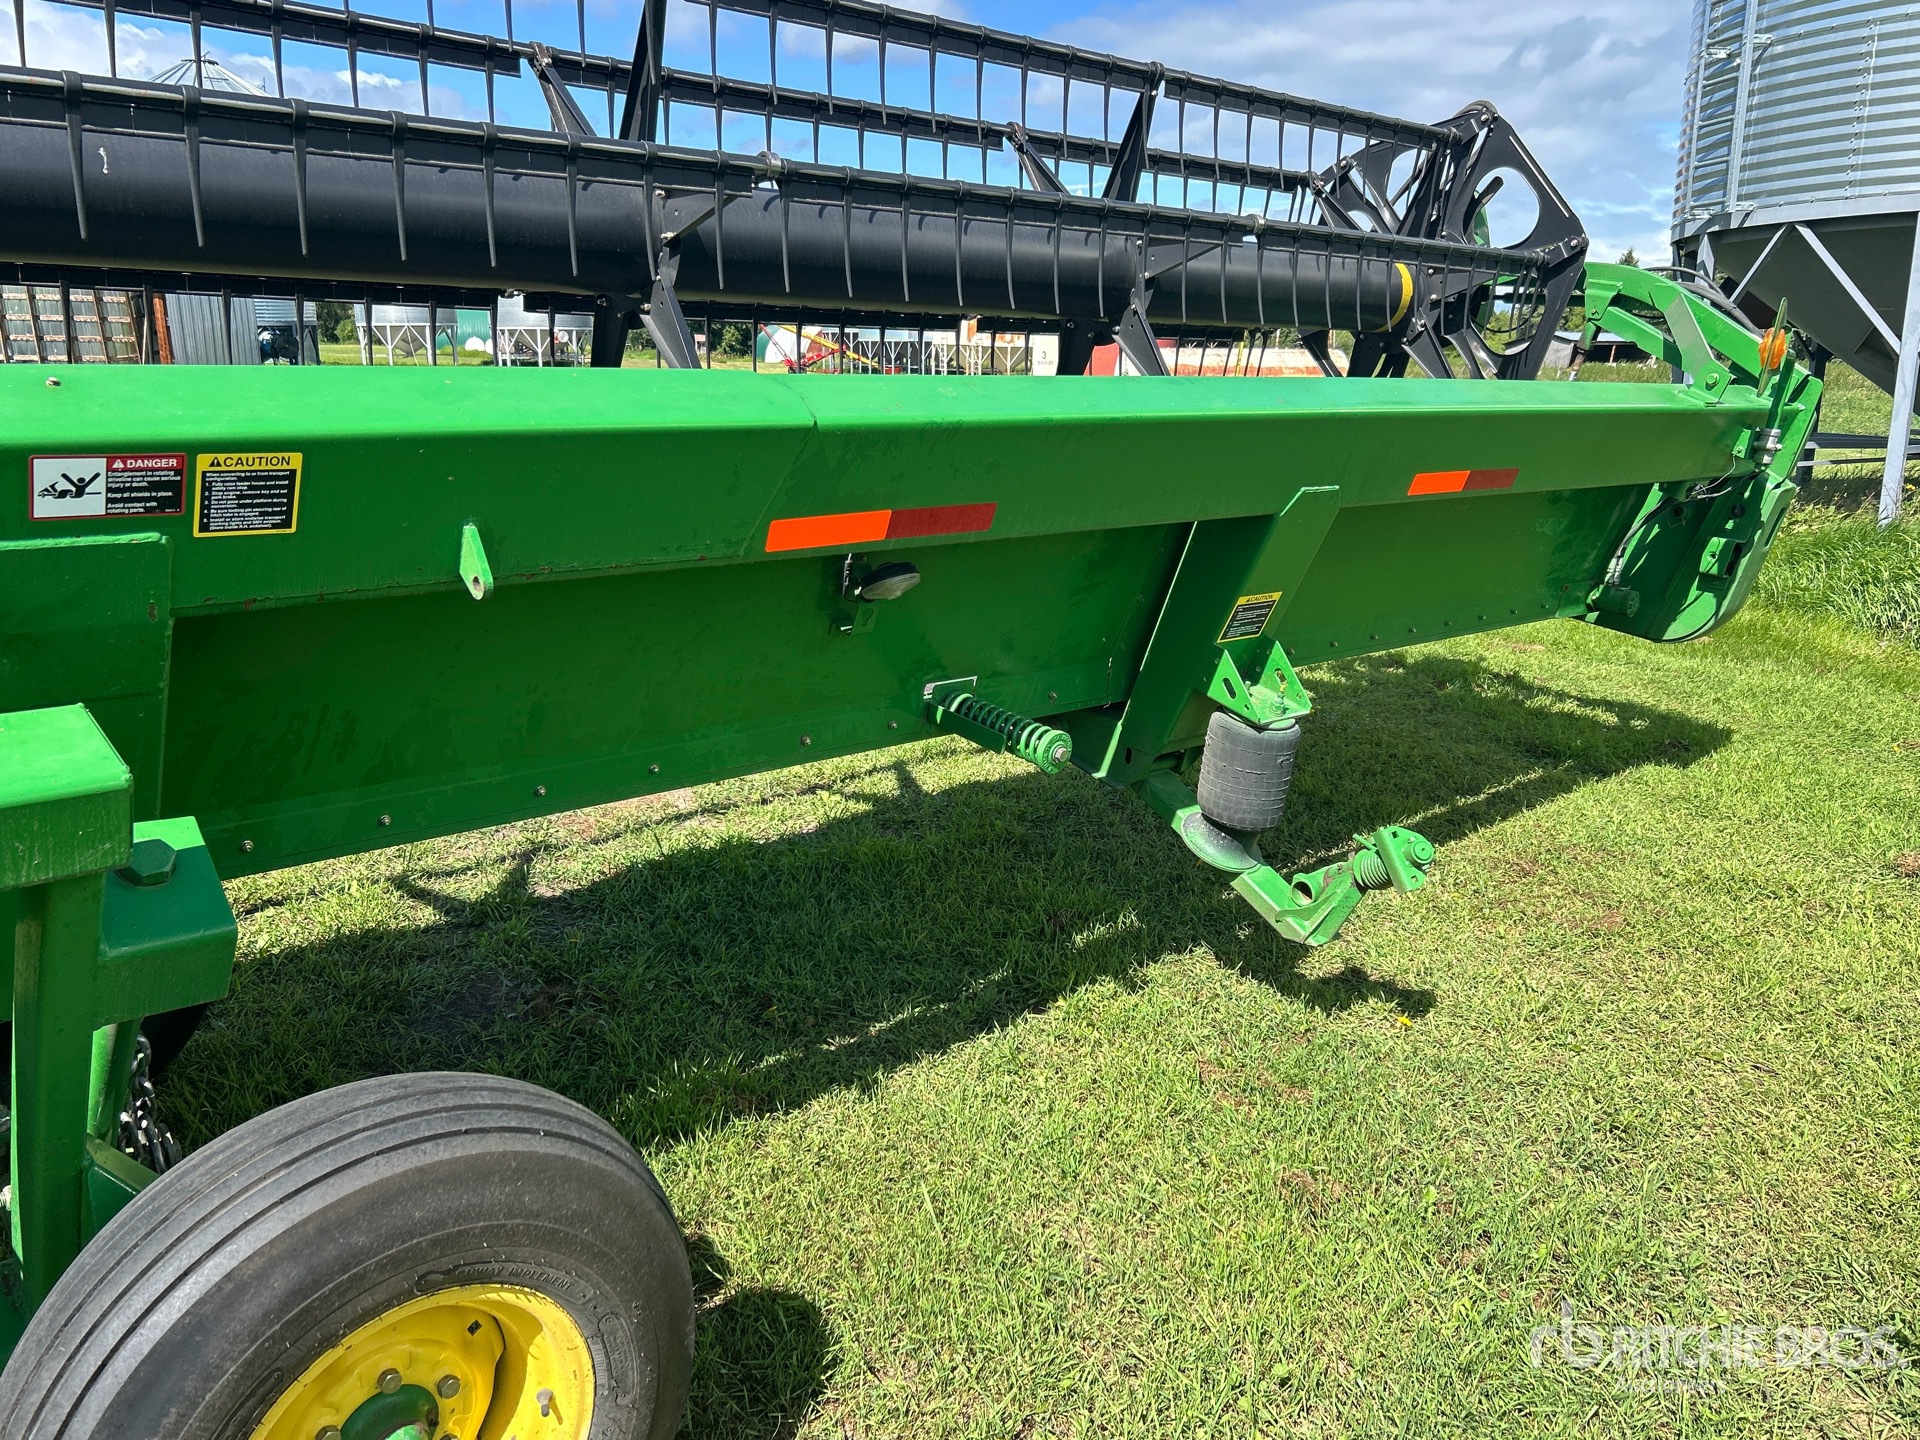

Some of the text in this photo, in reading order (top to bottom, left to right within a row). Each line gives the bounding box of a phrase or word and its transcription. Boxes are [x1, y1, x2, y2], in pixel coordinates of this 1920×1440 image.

[1042, 350, 1046, 359] 3
[127, 459, 177, 468] DANGER
[224, 456, 290, 467] CAUTION
[508, 1267, 575, 1290] IMPLEMENT
